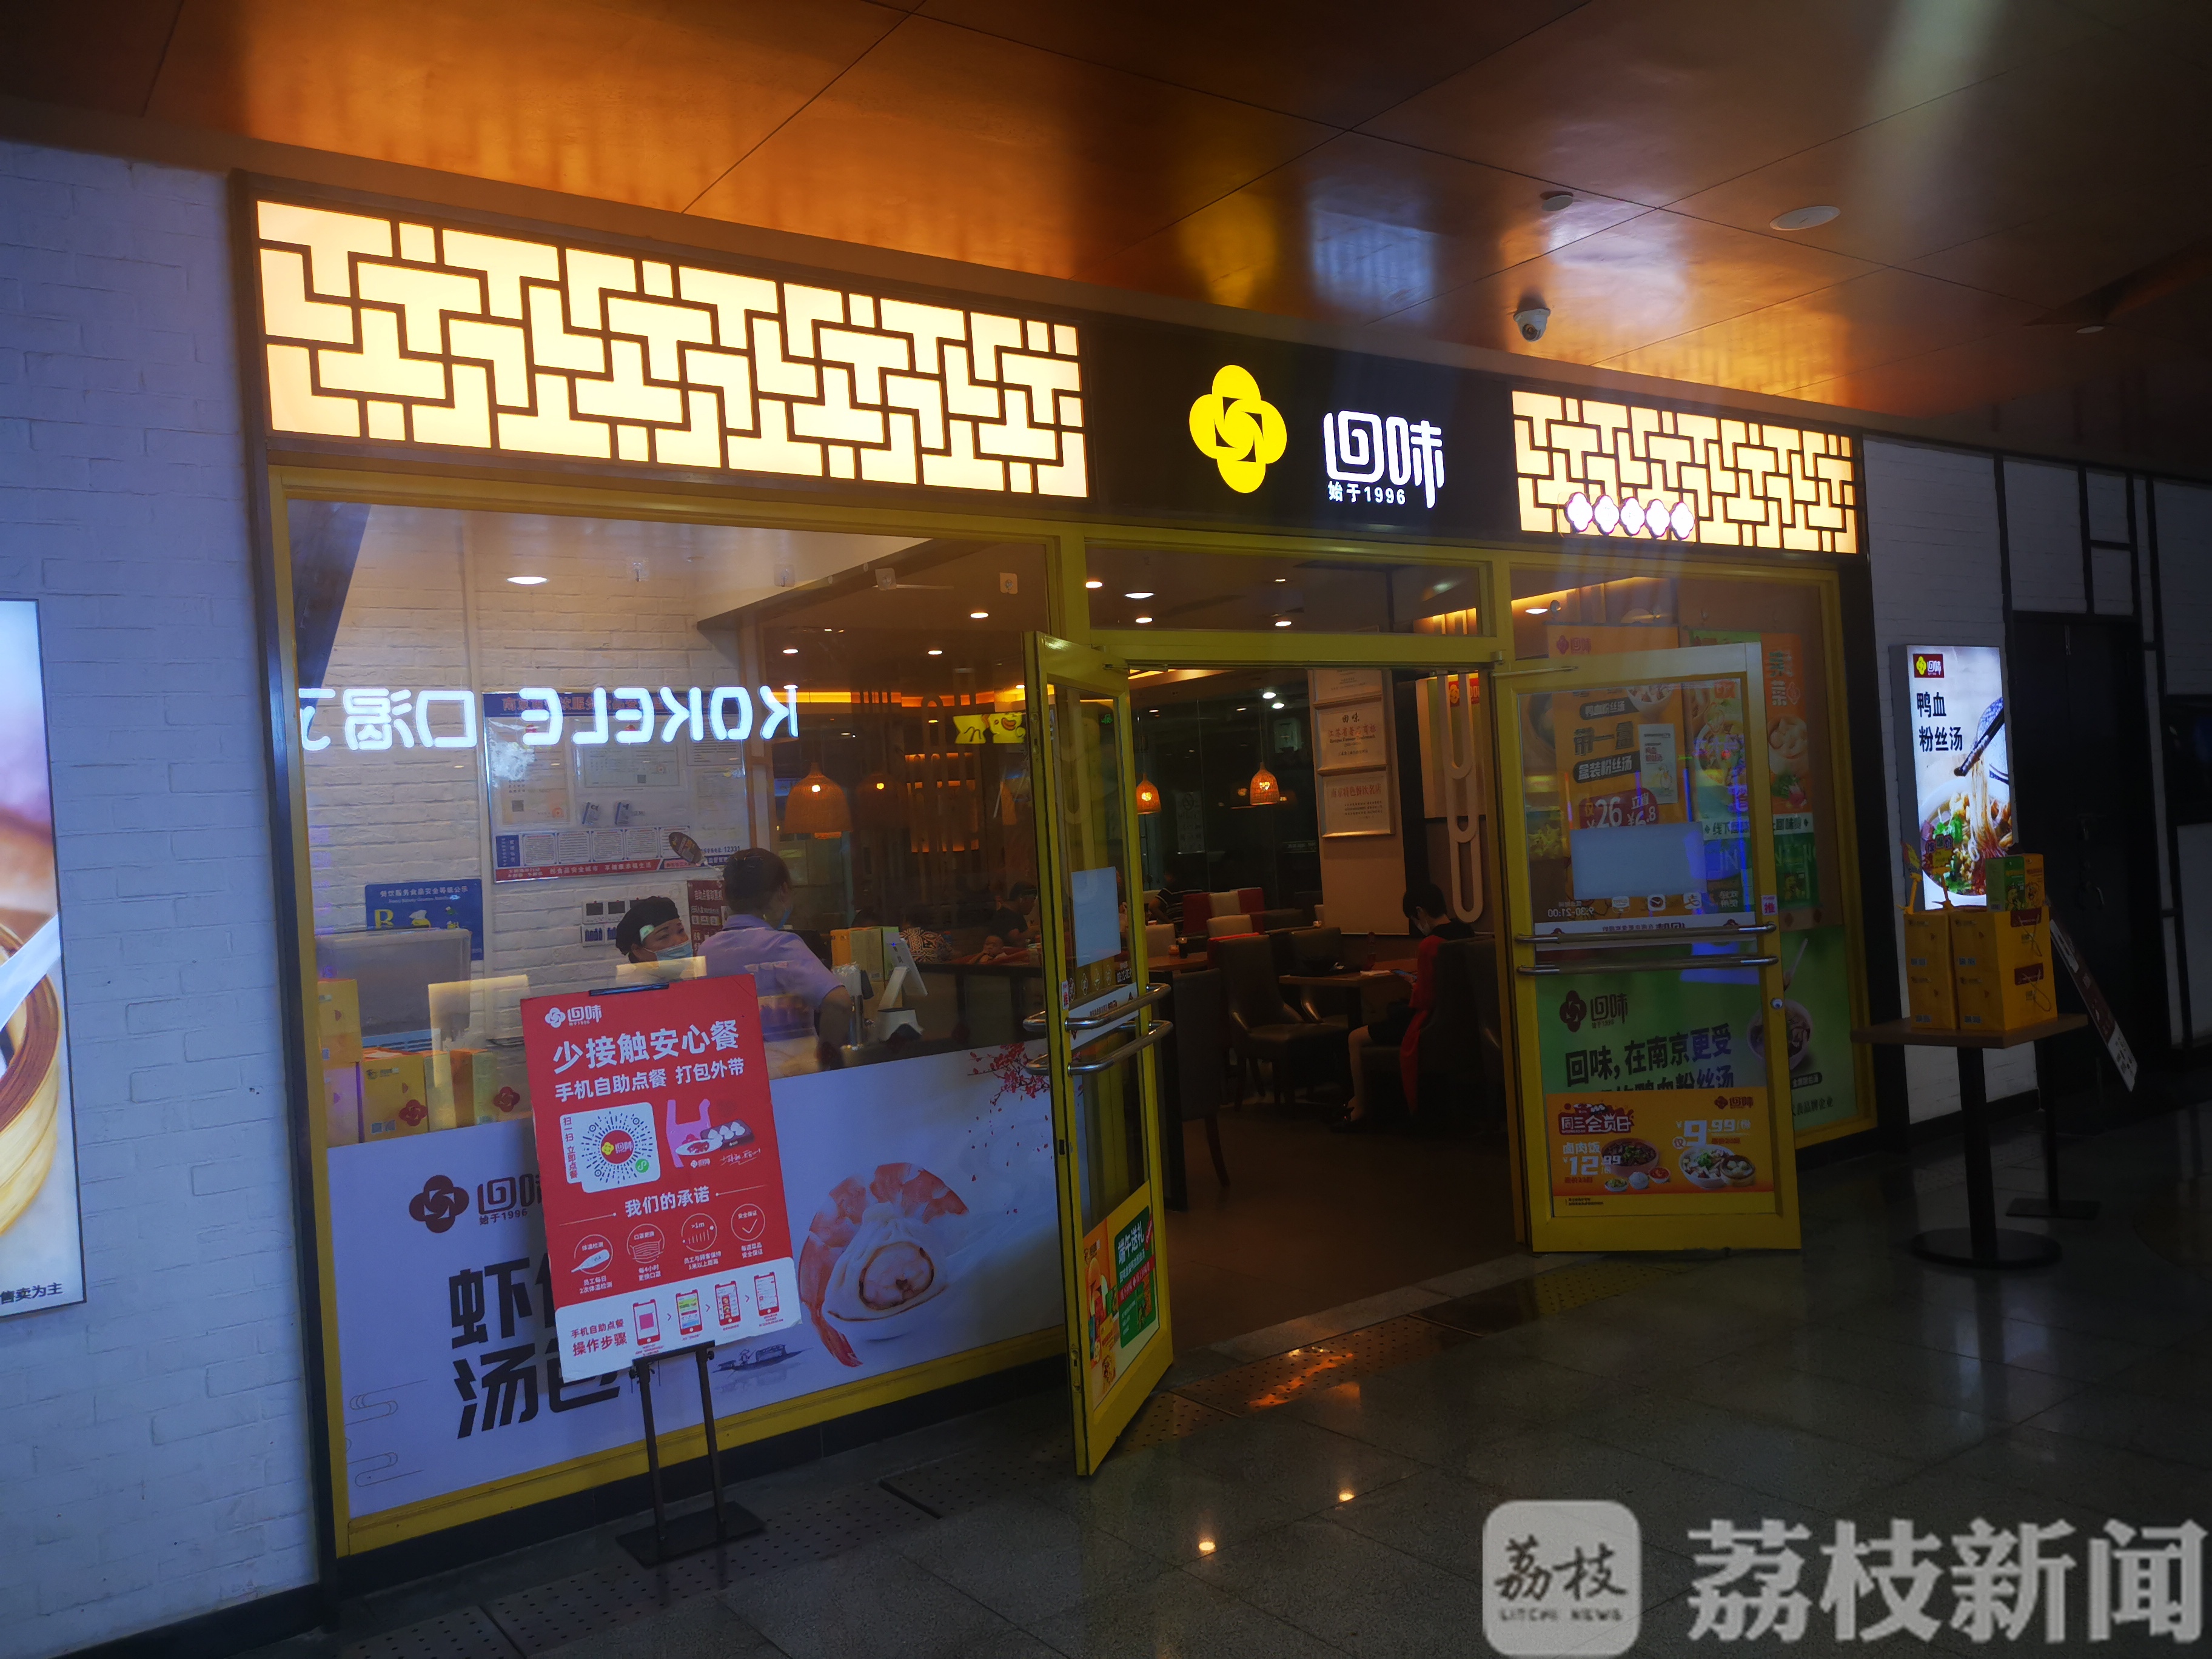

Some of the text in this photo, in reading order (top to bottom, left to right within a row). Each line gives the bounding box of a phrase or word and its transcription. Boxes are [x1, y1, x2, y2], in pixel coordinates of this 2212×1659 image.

[1323, 410, 1445, 509] 回味
[1328, 480, 1406, 504] 始于1996
[1927, 660, 1942, 675] 回味
[1917, 692, 1947, 718] 鸭血
[1919, 726, 1963, 752] 粉丝汤
[1578, 755, 1632, 780] 盒装粉丝汤
[567, 1004, 602, 1023] 回味
[1590, 993, 1628, 1024] 回味
[552, 1019, 739, 1074] 少接触安心餐
[555, 1057, 745, 1102] 手机自助点餐 打包外带
[1729, 1096, 1754, 1109] 回味
[563, 1116, 574, 1142] 扫一扫
[567, 1145, 577, 1179] 立即点餐
[625, 1185, 710, 1218] 我们的承诺
[479, 1209, 528, 1225] 始于1996
[0, 1282, 63, 1304] 售卖为主
[571, 1318, 624, 1339] 手机自助点餐
[573, 1332, 628, 1357] 操作步骤
